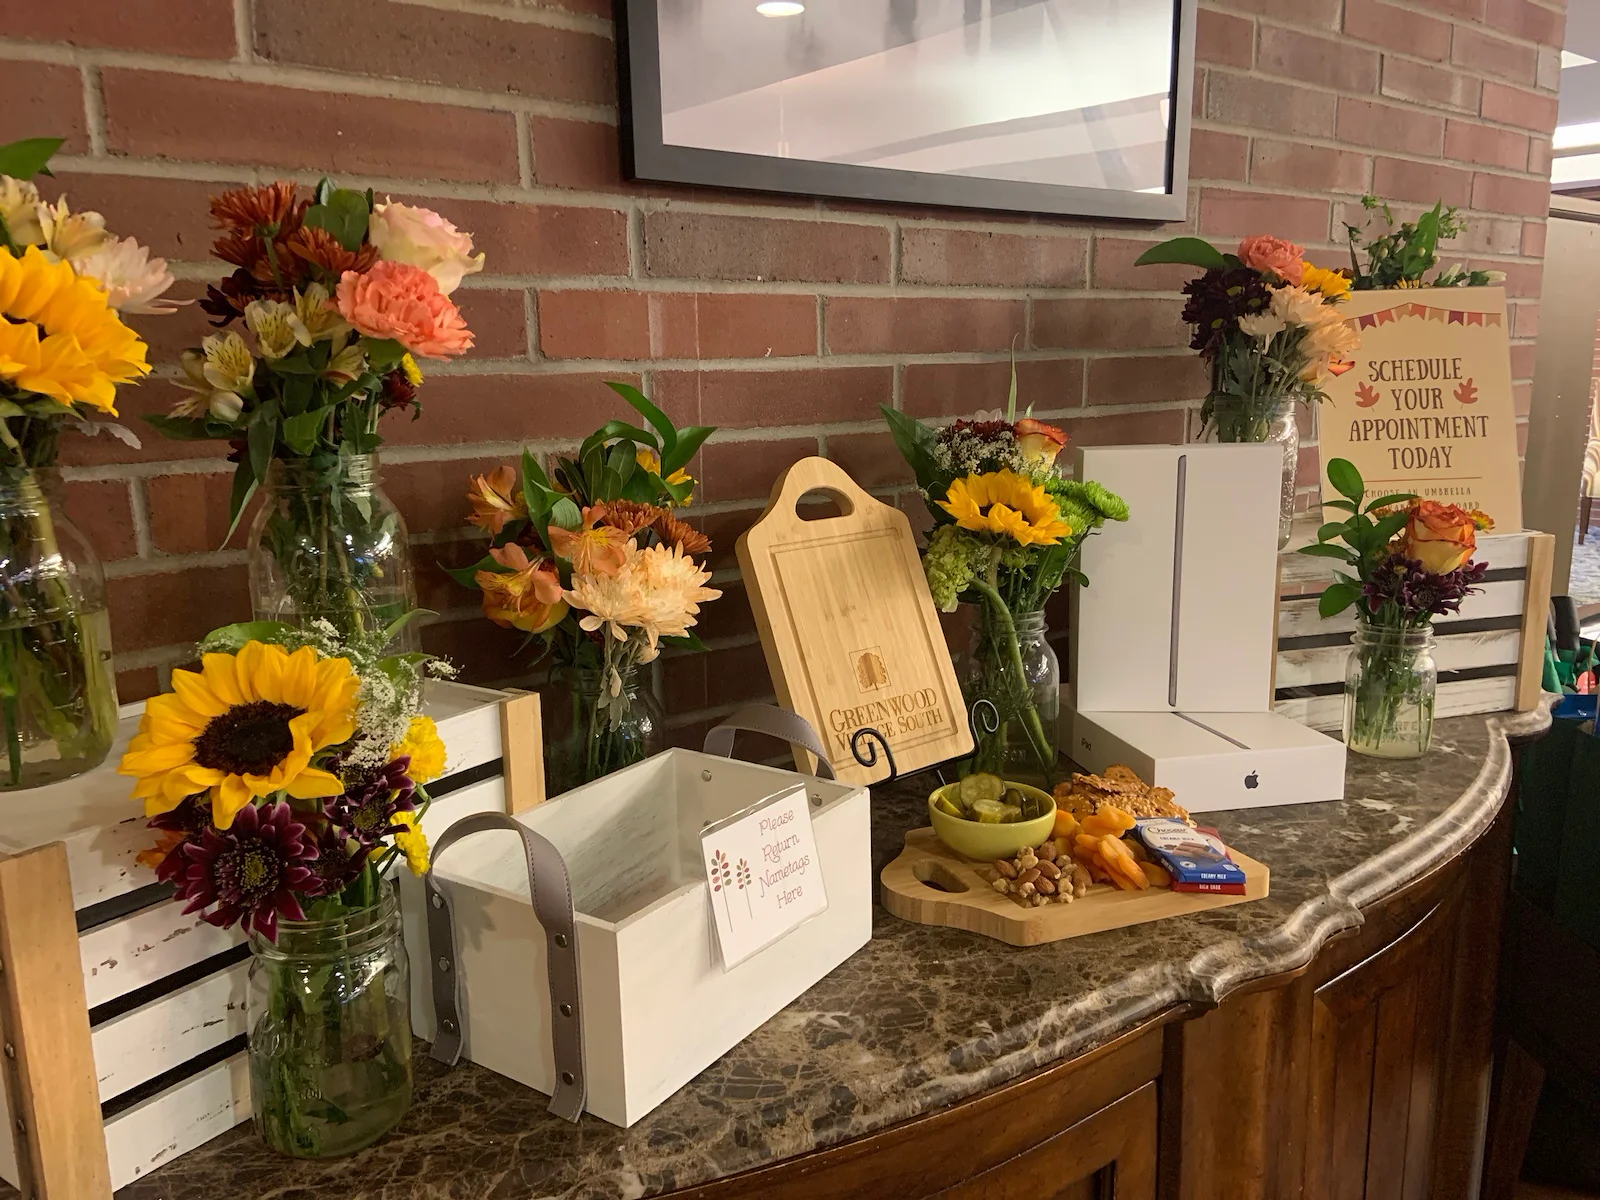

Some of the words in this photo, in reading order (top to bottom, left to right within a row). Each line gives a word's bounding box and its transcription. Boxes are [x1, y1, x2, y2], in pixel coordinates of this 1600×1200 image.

[1368, 358, 1463, 382] SCHEDULE
[1391, 388, 1444, 411] YOUR
[1349, 415, 1489, 441] APPOINTMENT
[1388, 446, 1452, 470] TODAY
[1425, 487, 1471, 496] UMBRELLA
[1455, 501, 1480, 510] OARD
[829, 688, 937, 732] GREENWOOD
[897, 708, 943, 734] SOUTH
[758, 809, 794, 836] Please
[762, 834, 800, 863] Return
[758, 854, 810, 898] Nametags
[776, 885, 803, 909] Here
